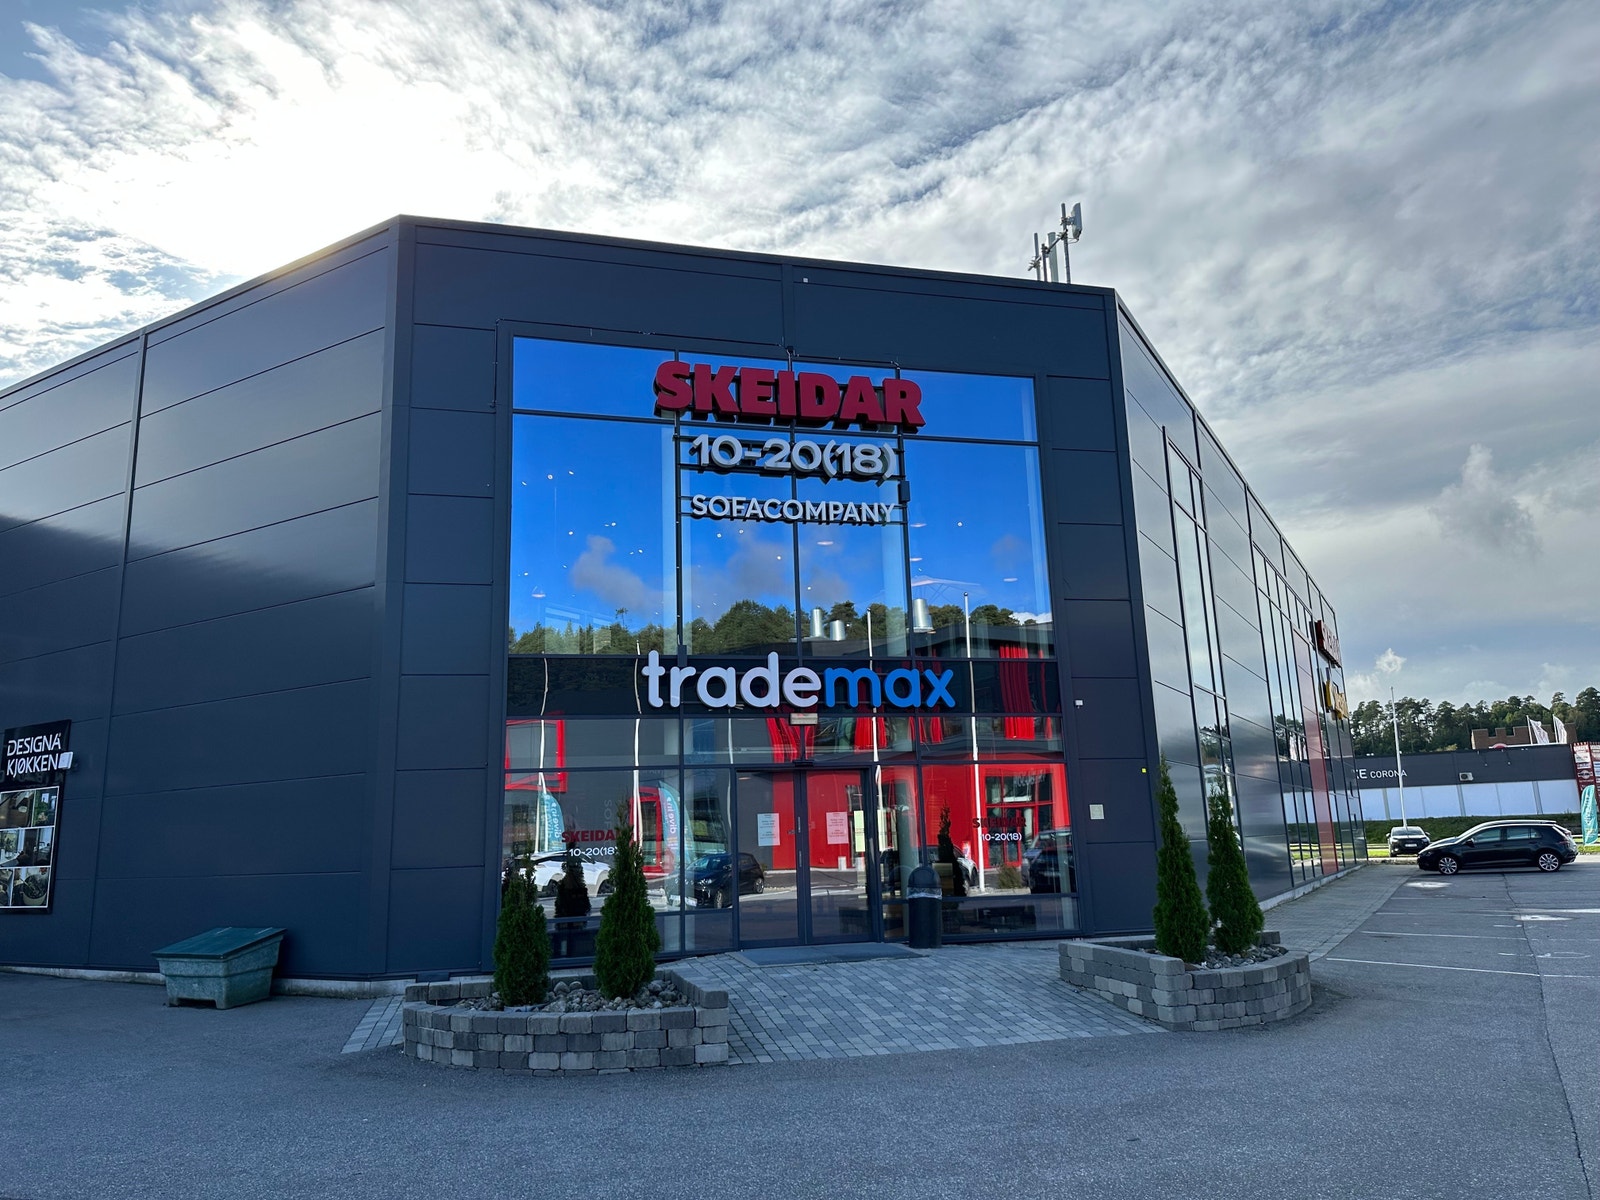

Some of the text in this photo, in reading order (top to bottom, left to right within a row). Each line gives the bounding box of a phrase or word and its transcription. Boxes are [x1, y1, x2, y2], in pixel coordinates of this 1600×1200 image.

[655, 361, 926, 428] SKEIDAR
[692, 434, 897, 482] 10-20(18)
[692, 494, 896, 523] SOFACOMPANY
[641, 649, 956, 708] trademax
[6, 733, 61, 756] DESIGNA
[6, 753, 59, 778] KJØKKEN
[1370, 769, 1408, 779] CORONA
